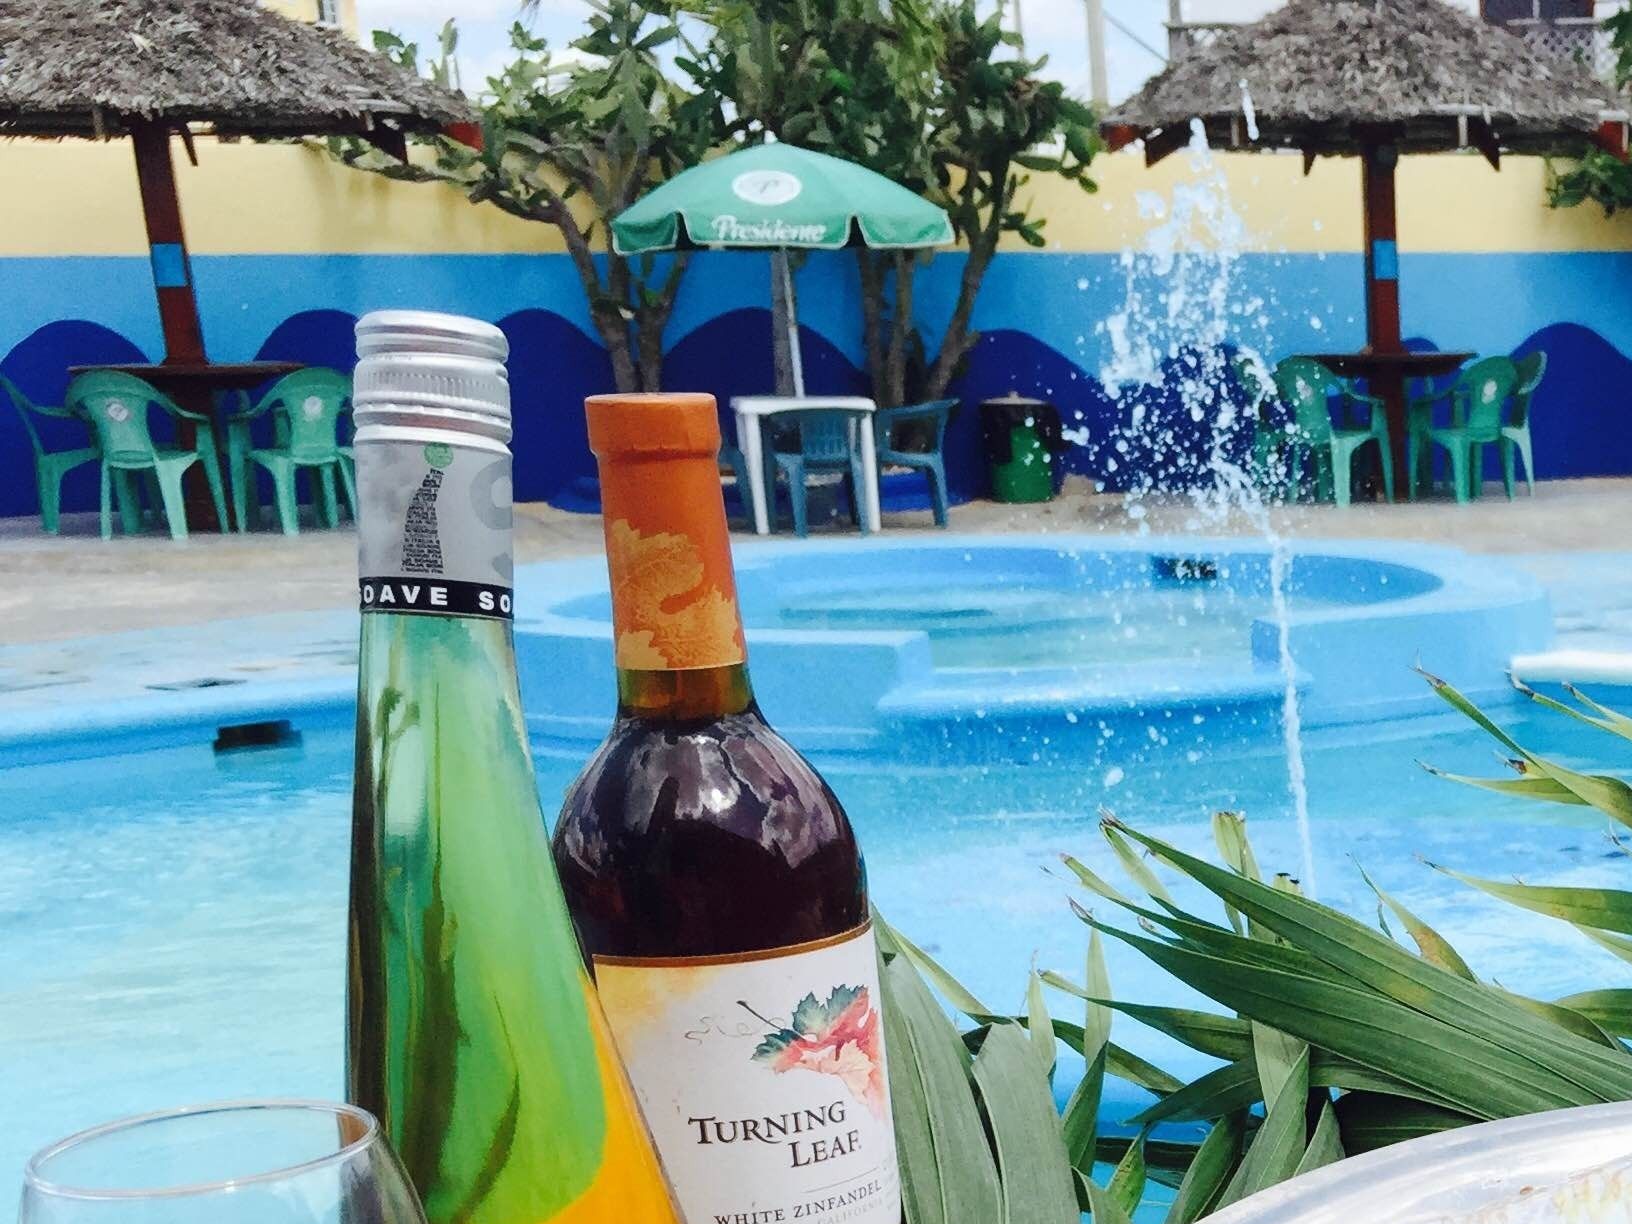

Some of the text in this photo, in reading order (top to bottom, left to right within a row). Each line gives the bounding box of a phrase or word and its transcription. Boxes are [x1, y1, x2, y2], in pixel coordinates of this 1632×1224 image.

[359, 584, 448, 607] OAVE
[687, 1100, 847, 1146] TURNING
[793, 1179, 883, 1219] ZINFANDEL
